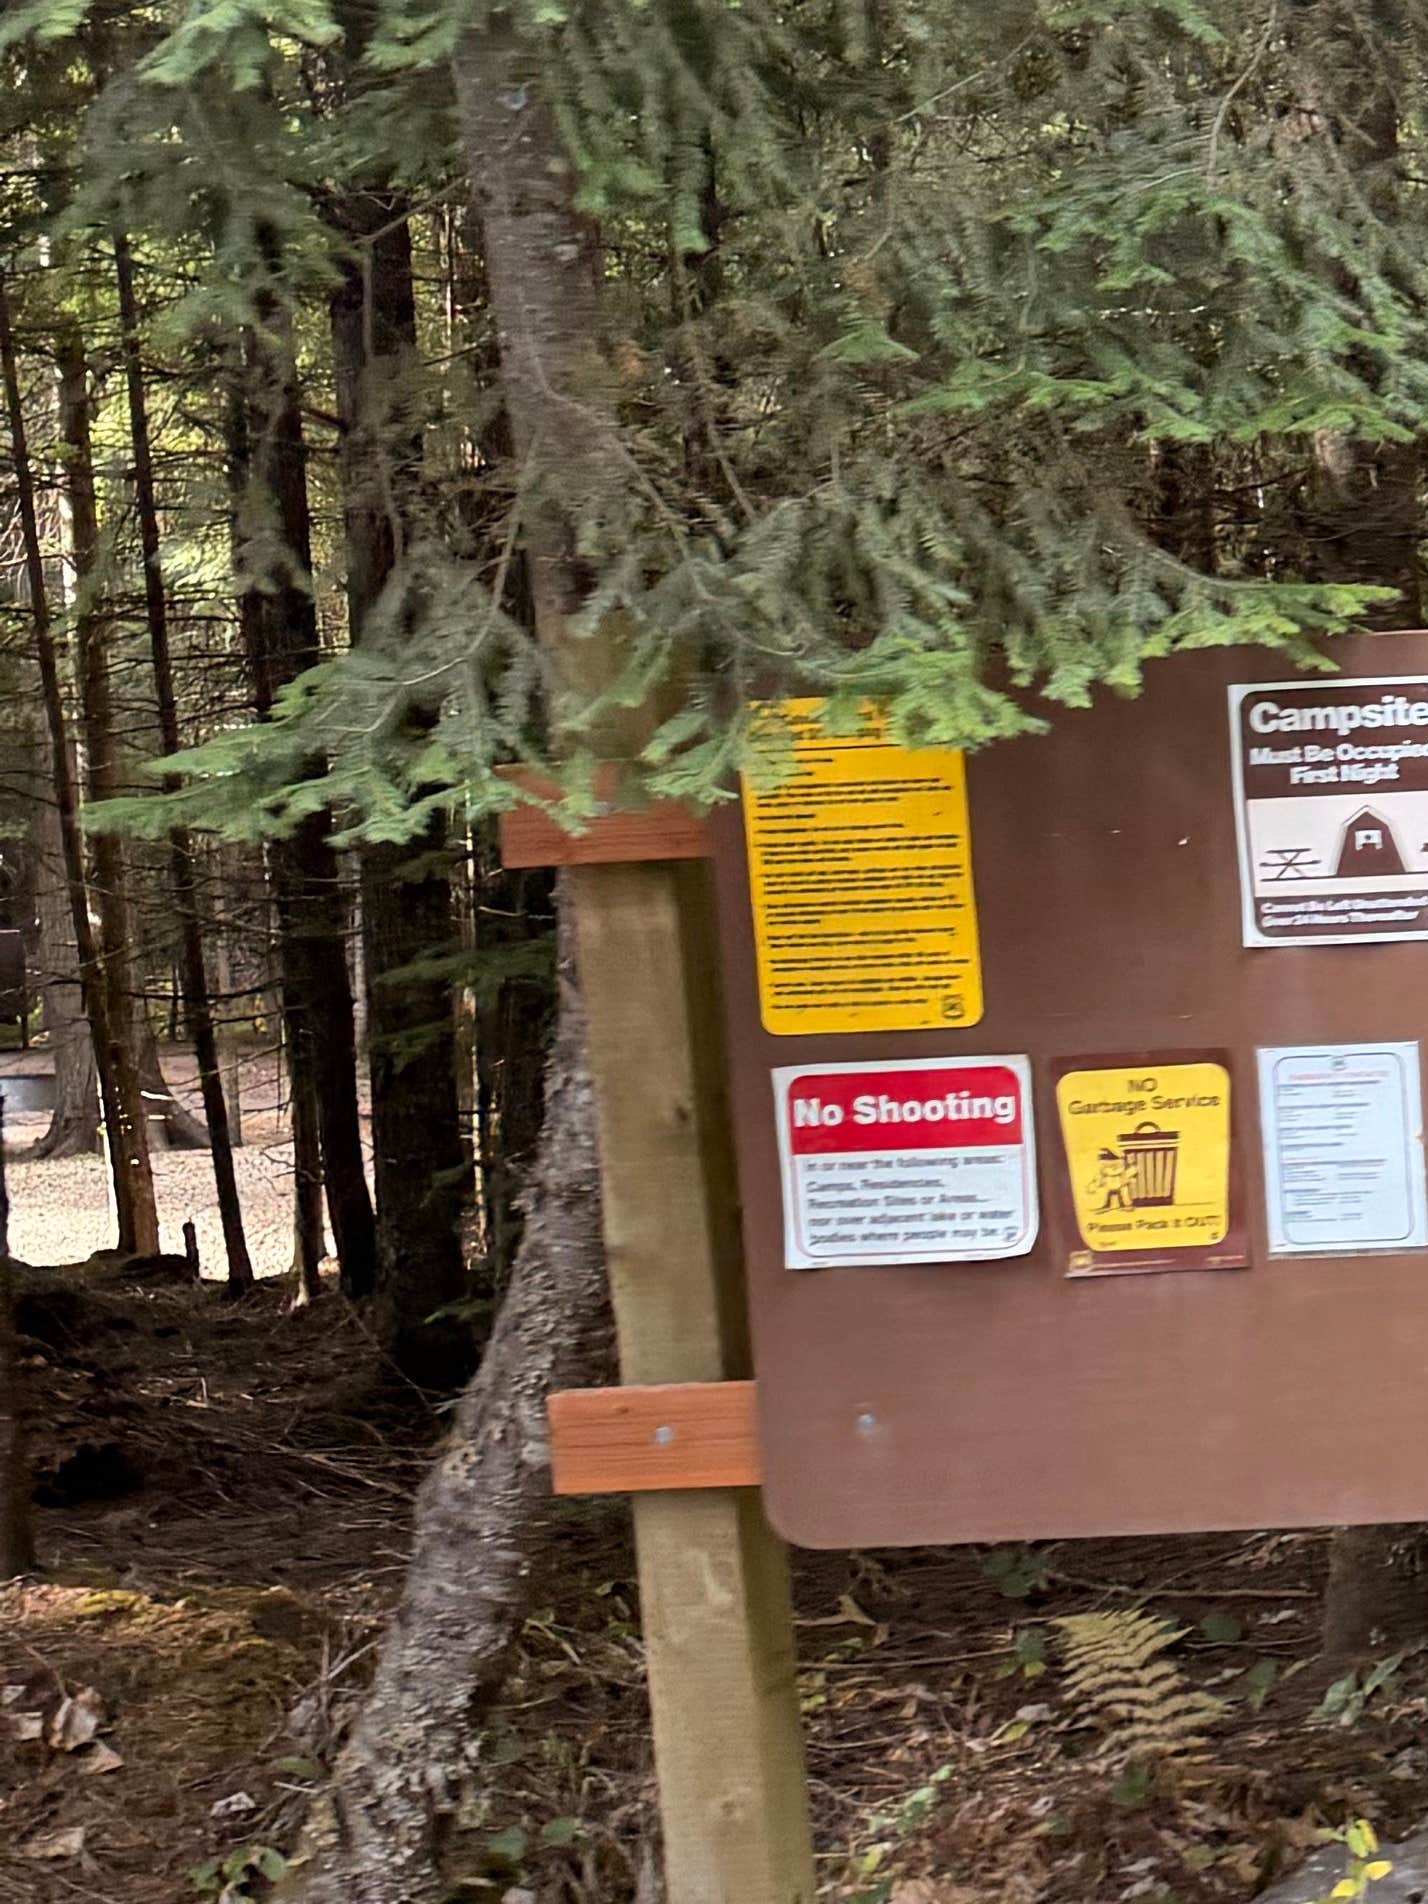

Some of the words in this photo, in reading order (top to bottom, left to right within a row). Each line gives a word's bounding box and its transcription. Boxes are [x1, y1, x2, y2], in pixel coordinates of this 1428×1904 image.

[1250, 747, 1302, 765] Must
[1304, 745, 1335, 762] Be
[1290, 765, 1339, 784] First
[1340, 763, 1400, 785] Night
[1127, 1077, 1158, 1093] NO
[793, 1098, 843, 1128] No
[853, 1091, 1016, 1125] Shooting
[1069, 1098, 1147, 1115] Garbage
[1151, 1095, 1220, 1111] Service
